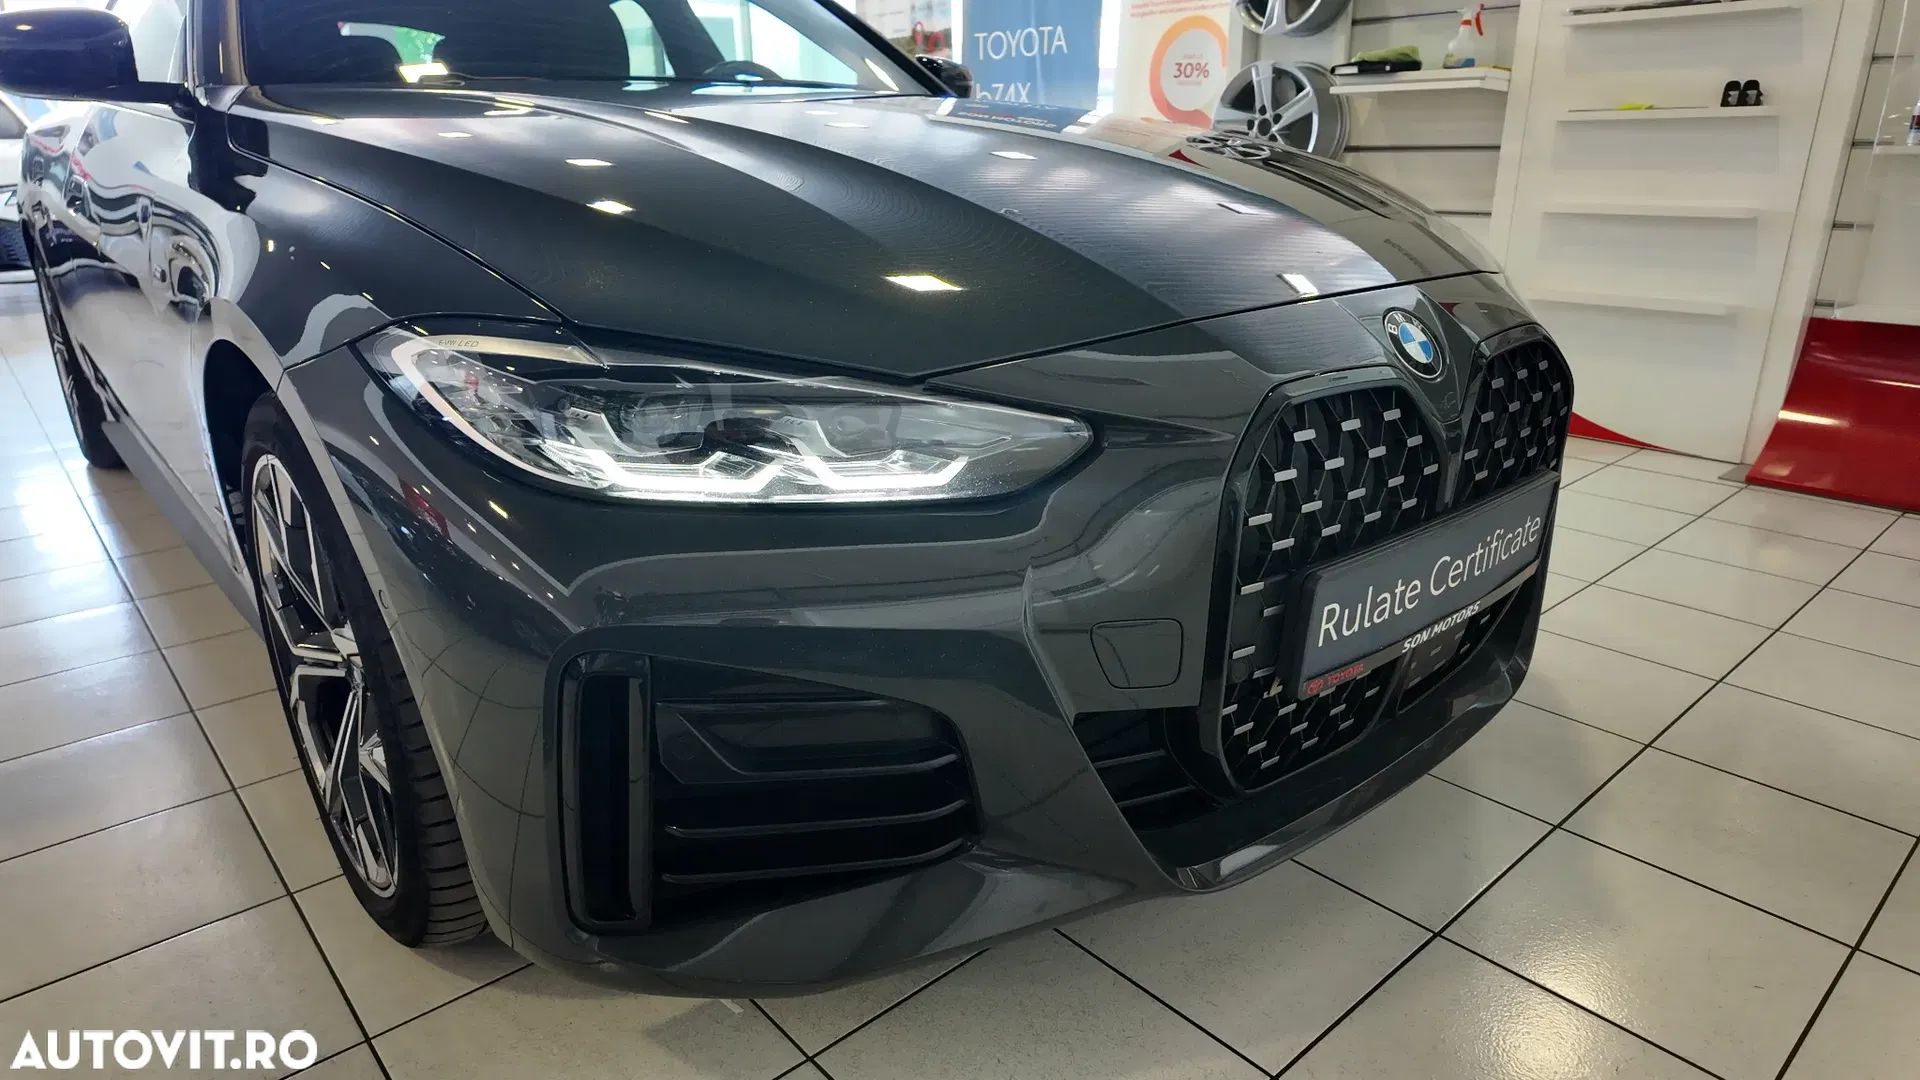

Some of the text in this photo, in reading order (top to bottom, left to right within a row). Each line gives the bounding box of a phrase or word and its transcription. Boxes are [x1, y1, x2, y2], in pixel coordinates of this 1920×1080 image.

[974, 25, 1068, 60] TOYOTA
[1173, 62, 1210, 79] 30%
[457, 340, 480, 348] LED
[1317, 515, 1541, 647] Rulate Certificate
[1401, 601, 1481, 653] SON MOTORS
[1327, 663, 1364, 685] TOYOTA
